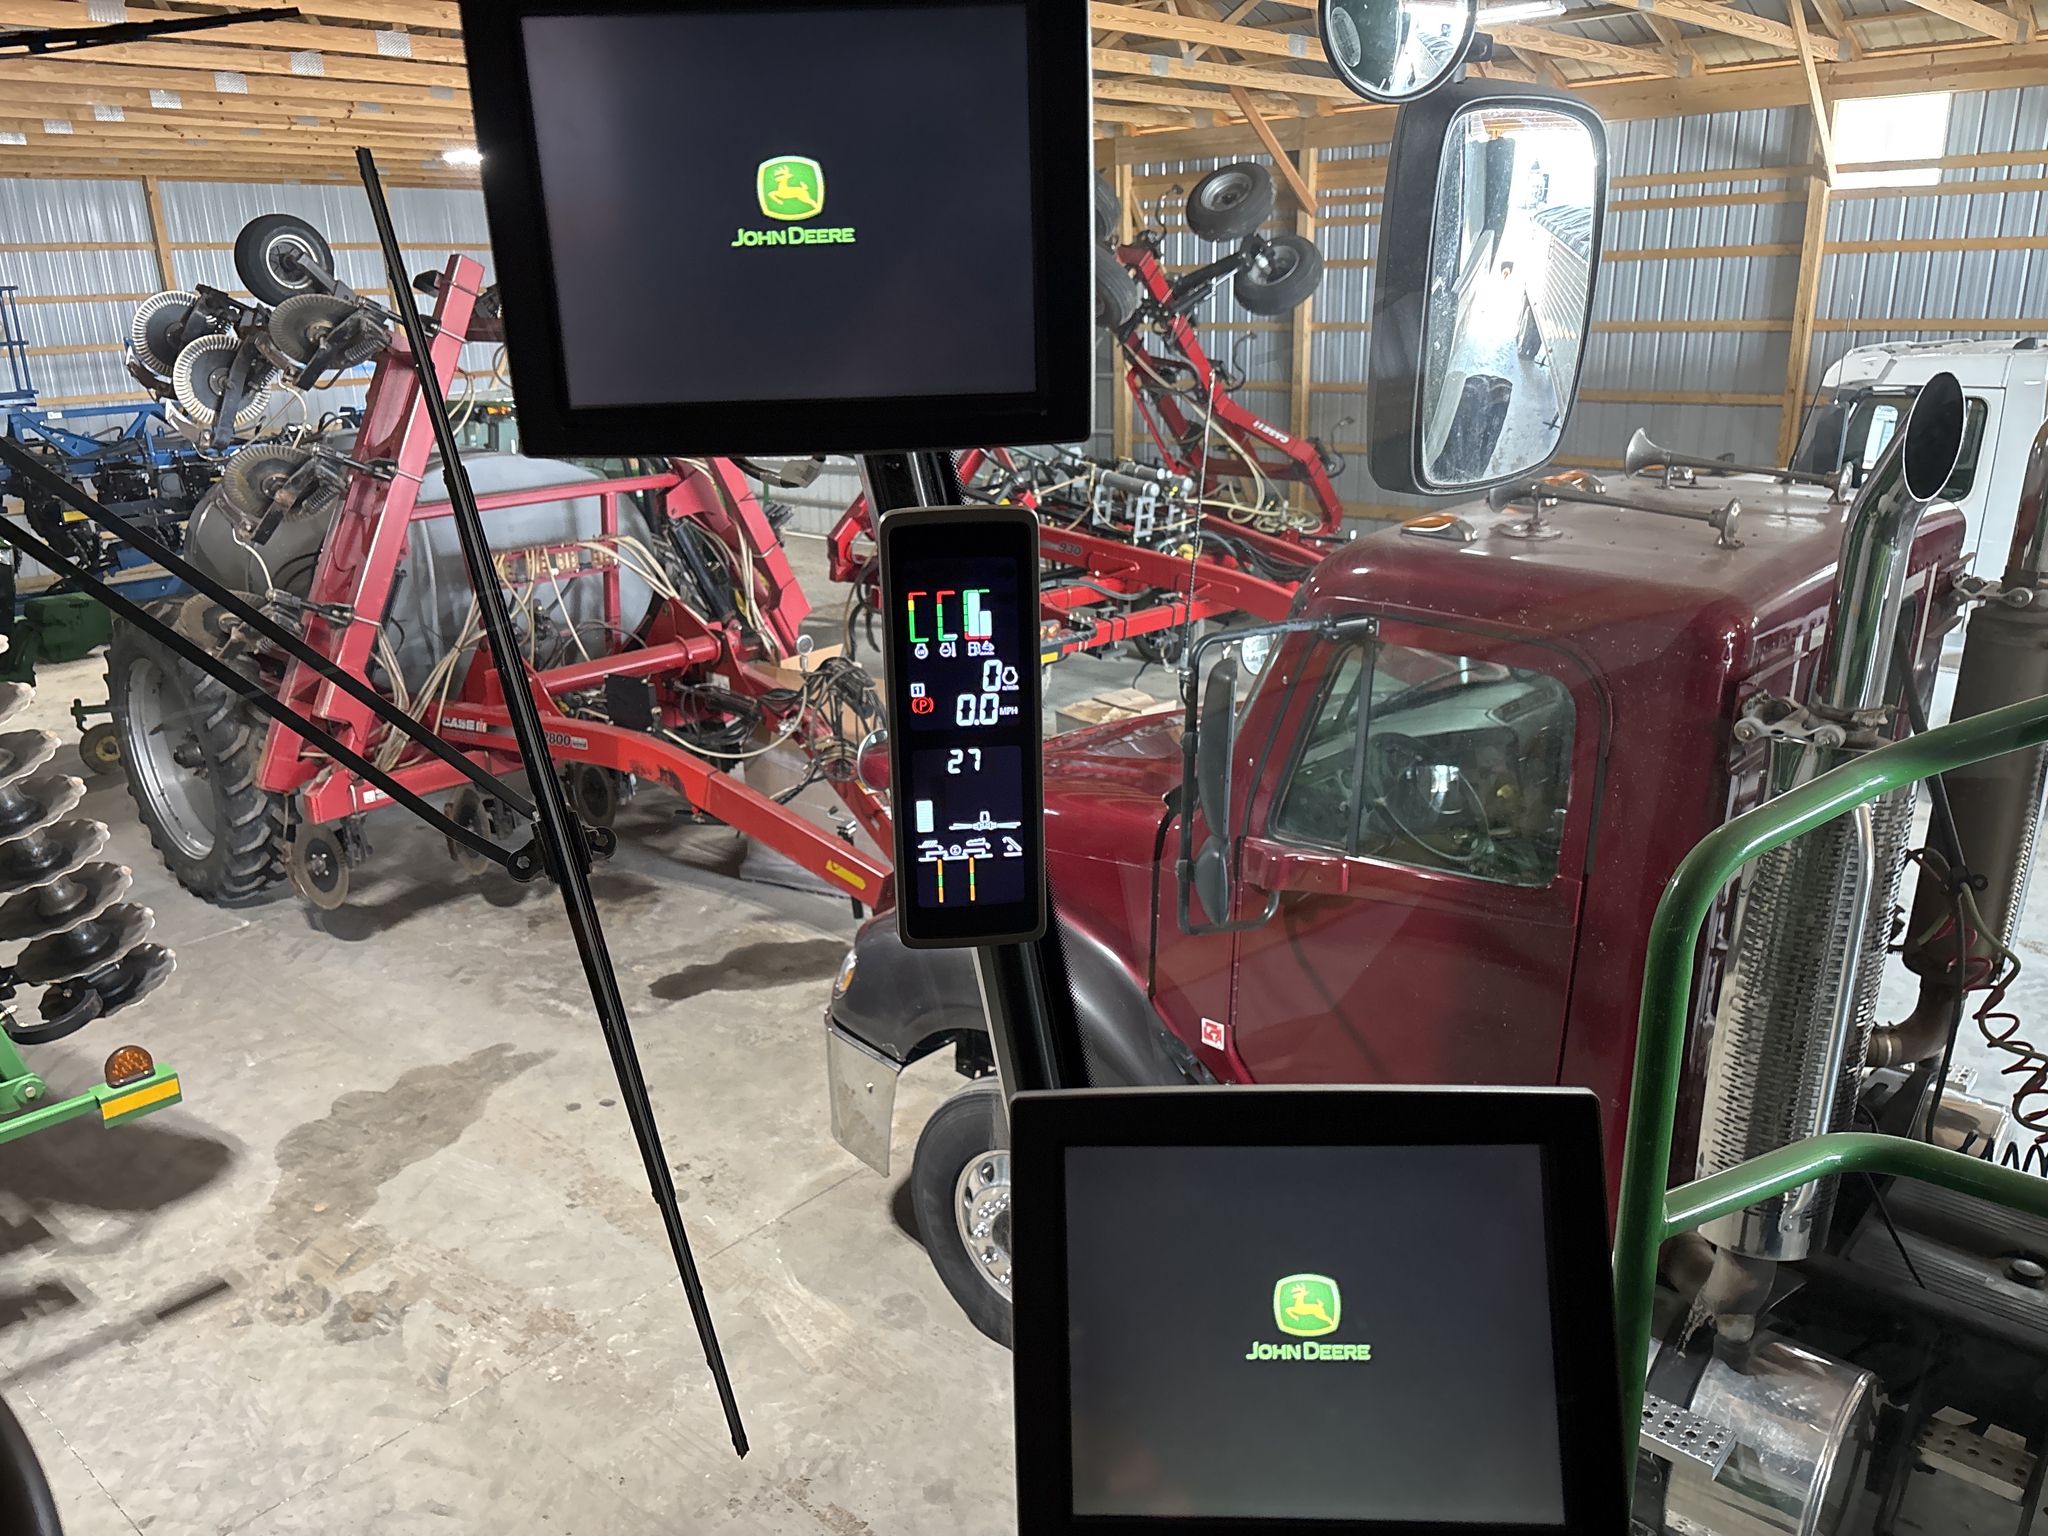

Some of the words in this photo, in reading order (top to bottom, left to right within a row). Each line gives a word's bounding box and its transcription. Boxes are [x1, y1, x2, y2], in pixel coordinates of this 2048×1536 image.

[1059, 542, 1082, 556] 930
[982, 659, 1003, 692] 0
[956, 693, 1000, 726] 0.0
[999, 706, 1019, 716] MPH
[442, 716, 475, 731] CASE
[947, 748, 982, 774] 27
